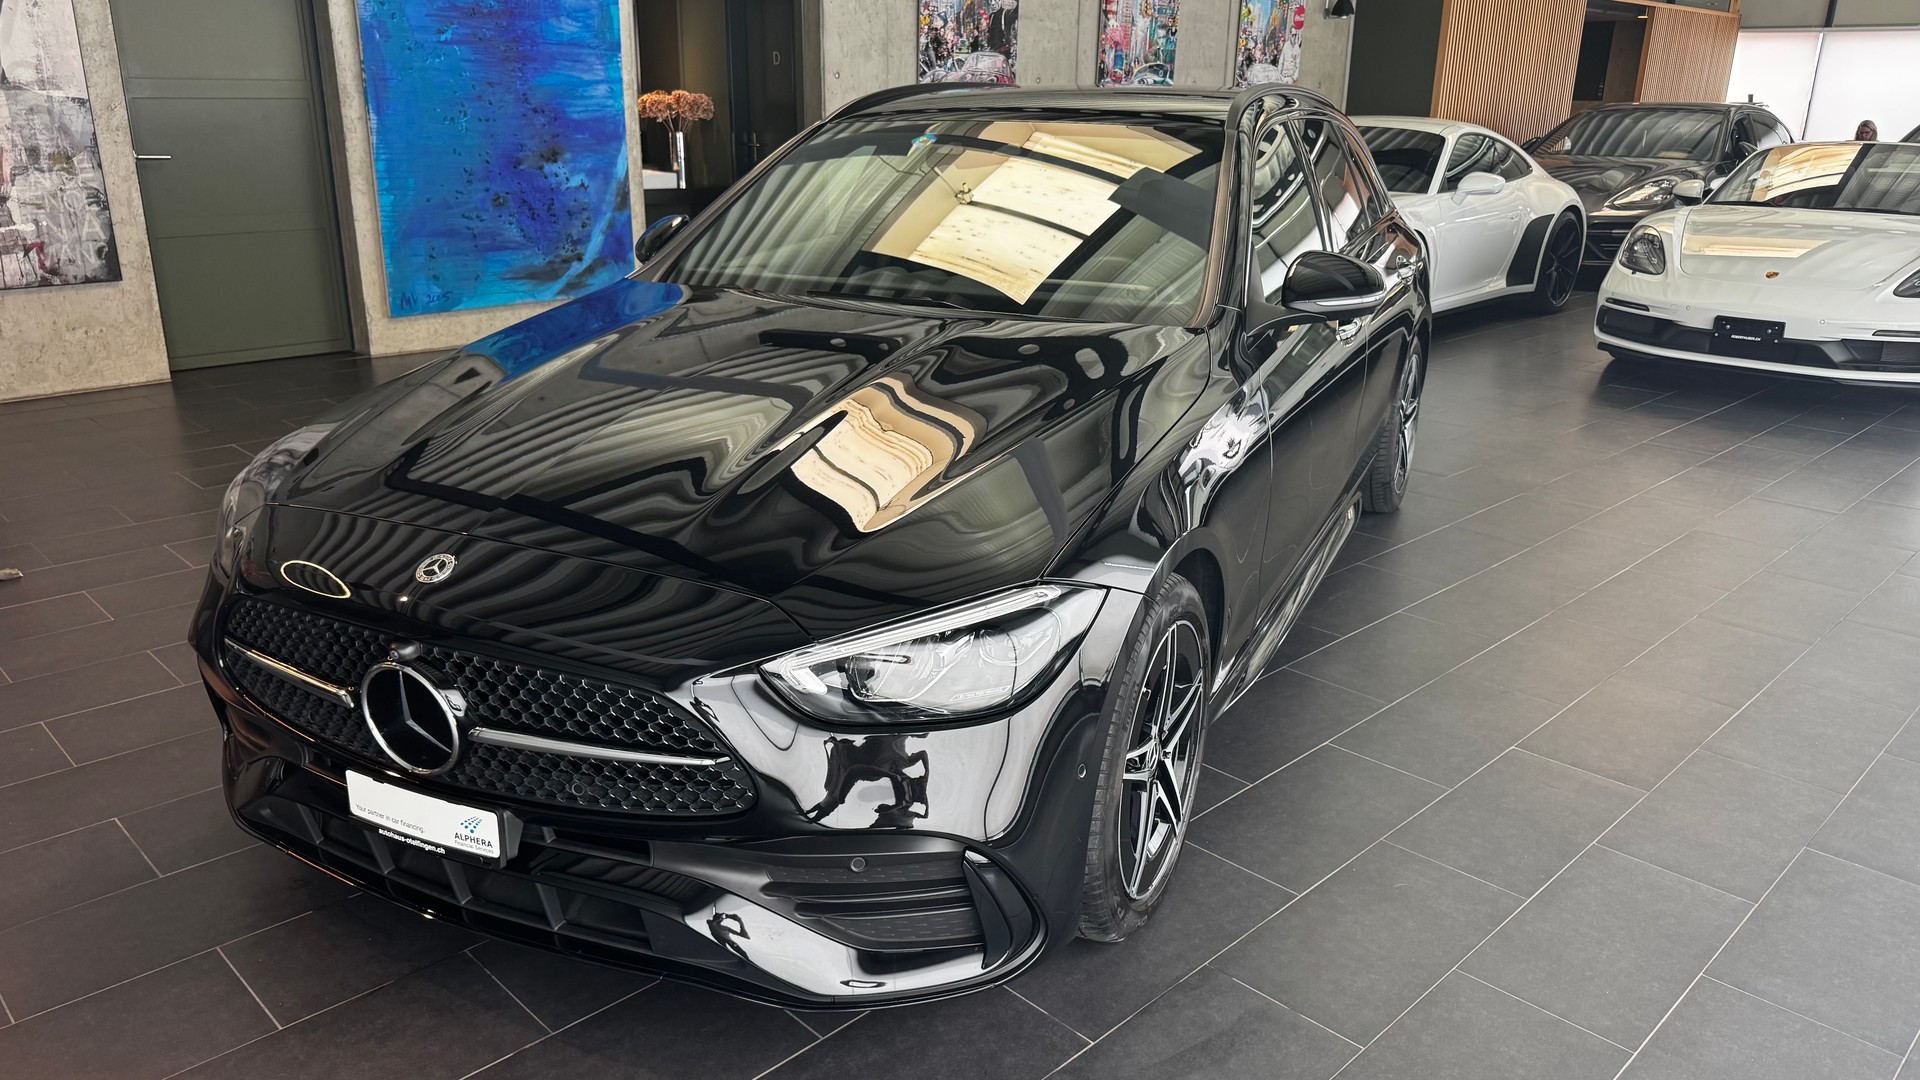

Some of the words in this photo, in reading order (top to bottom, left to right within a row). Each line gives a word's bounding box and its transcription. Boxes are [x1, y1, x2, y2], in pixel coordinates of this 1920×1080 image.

[772, 51, 781, 65] D
[355, 804, 367, 813] Your
[367, 808, 385, 819] partner
[385, 813, 391, 821] in
[391, 817, 400, 825] car
[454, 832, 494, 848] ALPHERA
[454, 840, 474, 849] Financial
[474, 845, 494, 854] Services
